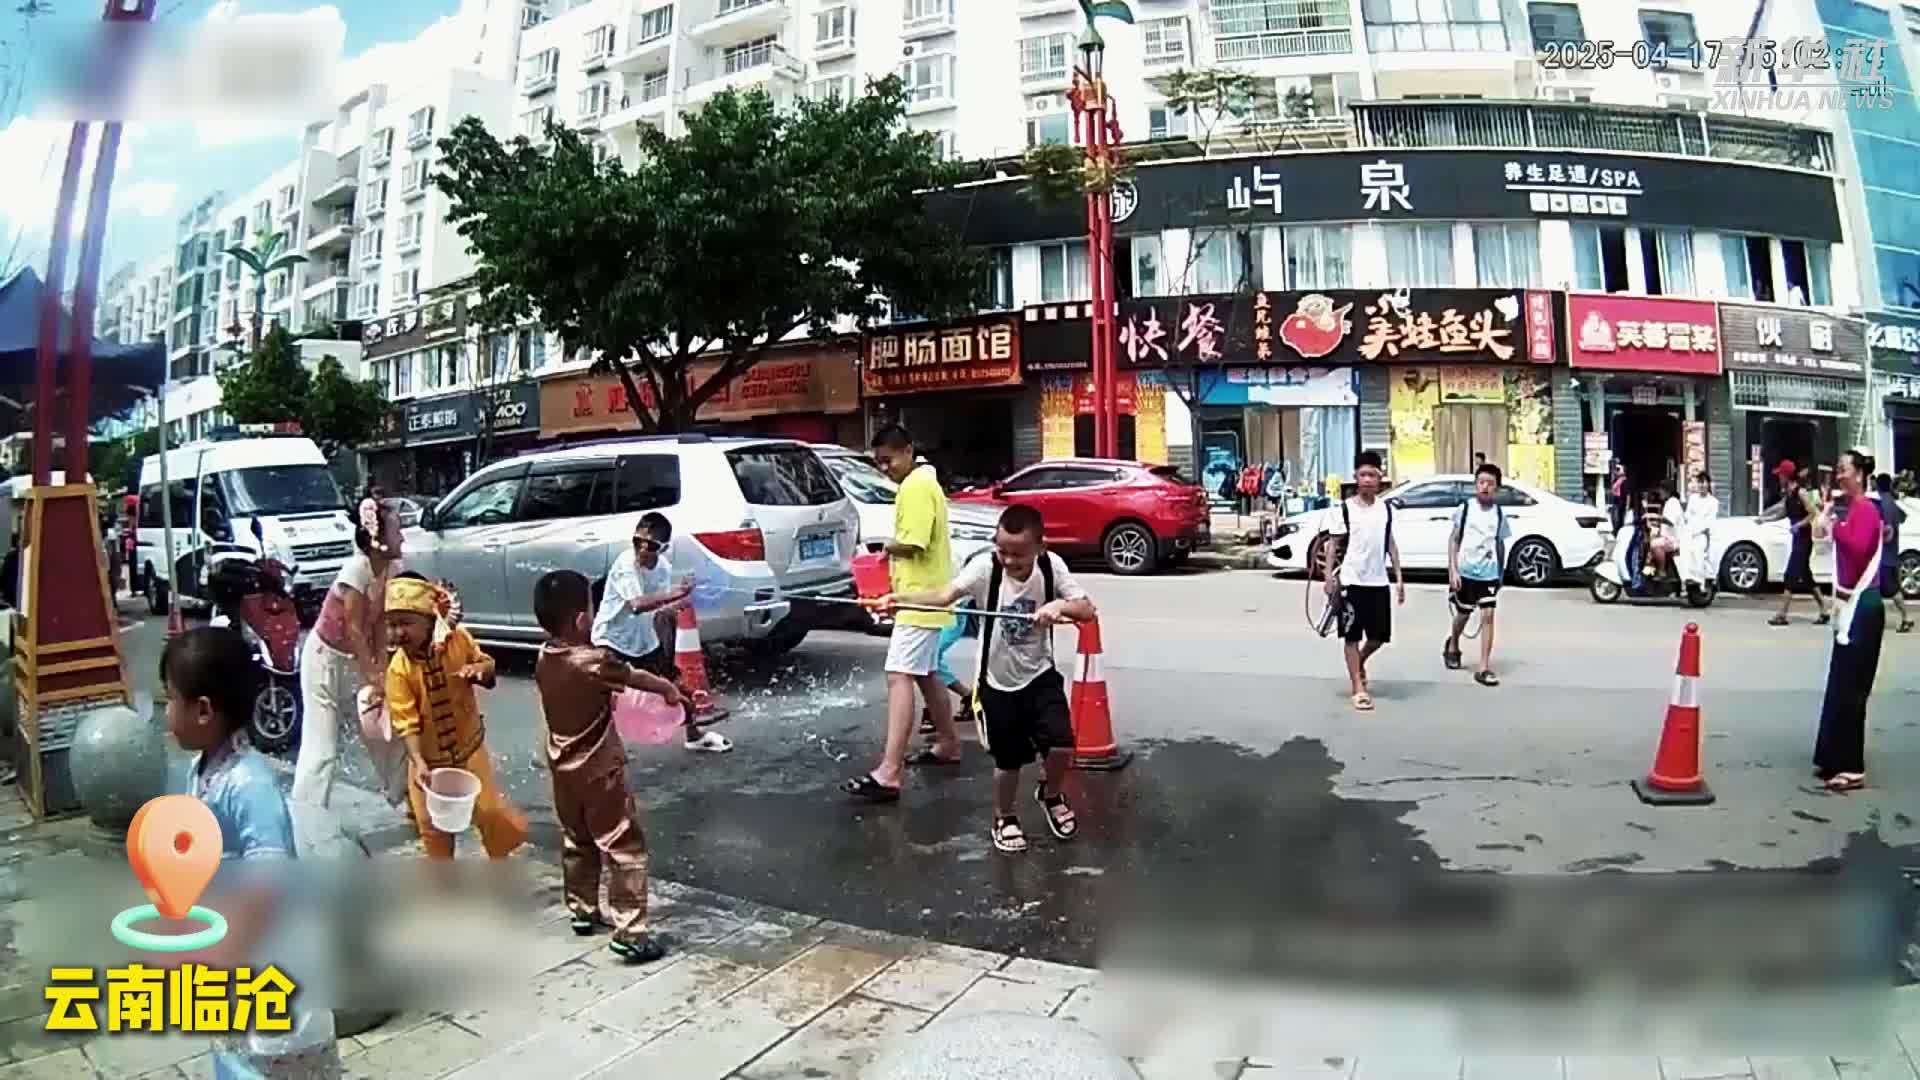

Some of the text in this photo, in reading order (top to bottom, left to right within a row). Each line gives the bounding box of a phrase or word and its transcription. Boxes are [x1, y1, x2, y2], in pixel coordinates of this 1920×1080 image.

[1226, 159, 1415, 214] 屿泉
[870, 323, 1012, 370] 肥肠面馆
[1118, 302, 1225, 363] 快餐
[1358, 294, 1516, 360] 美蛙鱼头
